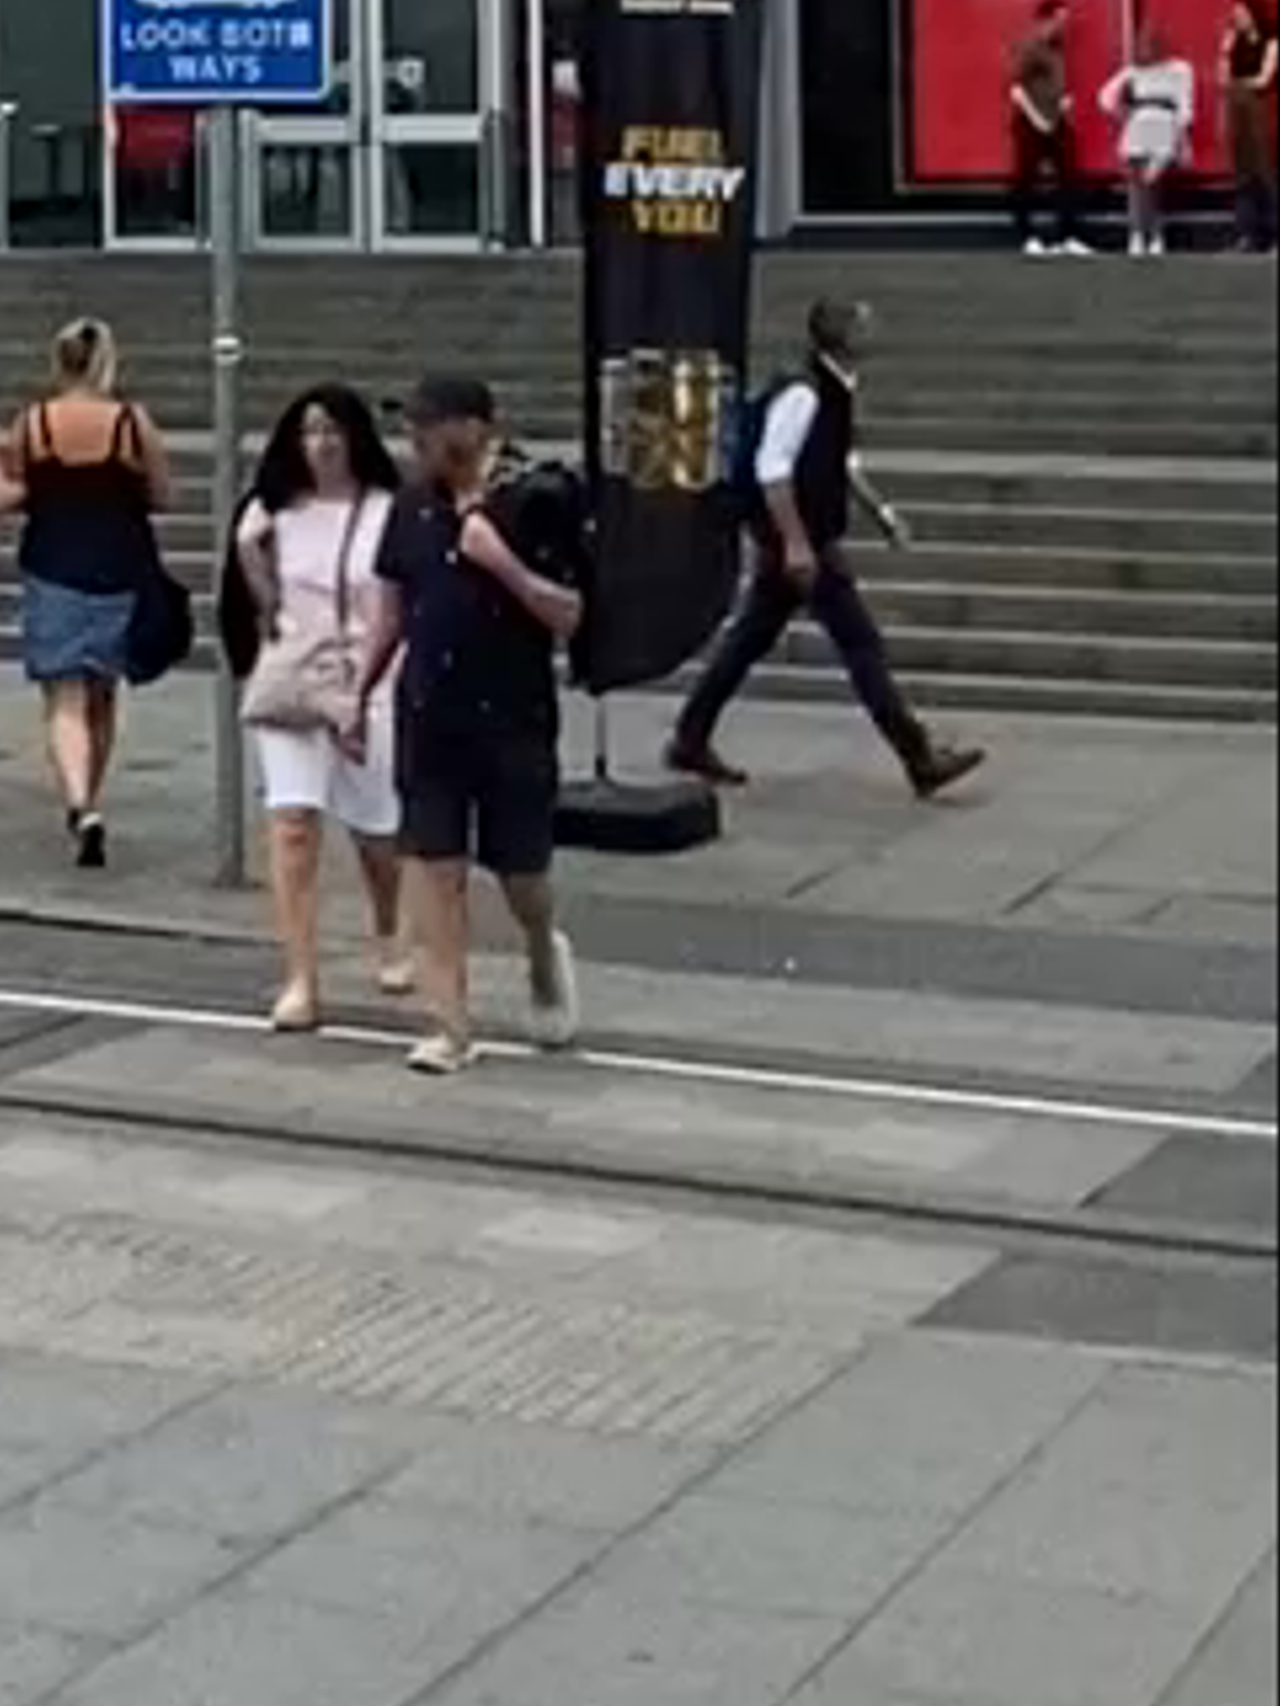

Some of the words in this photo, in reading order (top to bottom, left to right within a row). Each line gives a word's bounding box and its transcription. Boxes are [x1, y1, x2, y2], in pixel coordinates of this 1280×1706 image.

[120, 16, 213, 53] LOOK
[220, 16, 313, 49] BOTH
[167, 53, 264, 85] WAYS
[621, 123, 724, 160] FUEL
[604, 161, 746, 202] EVERY
[631, 198, 722, 236] YOU
